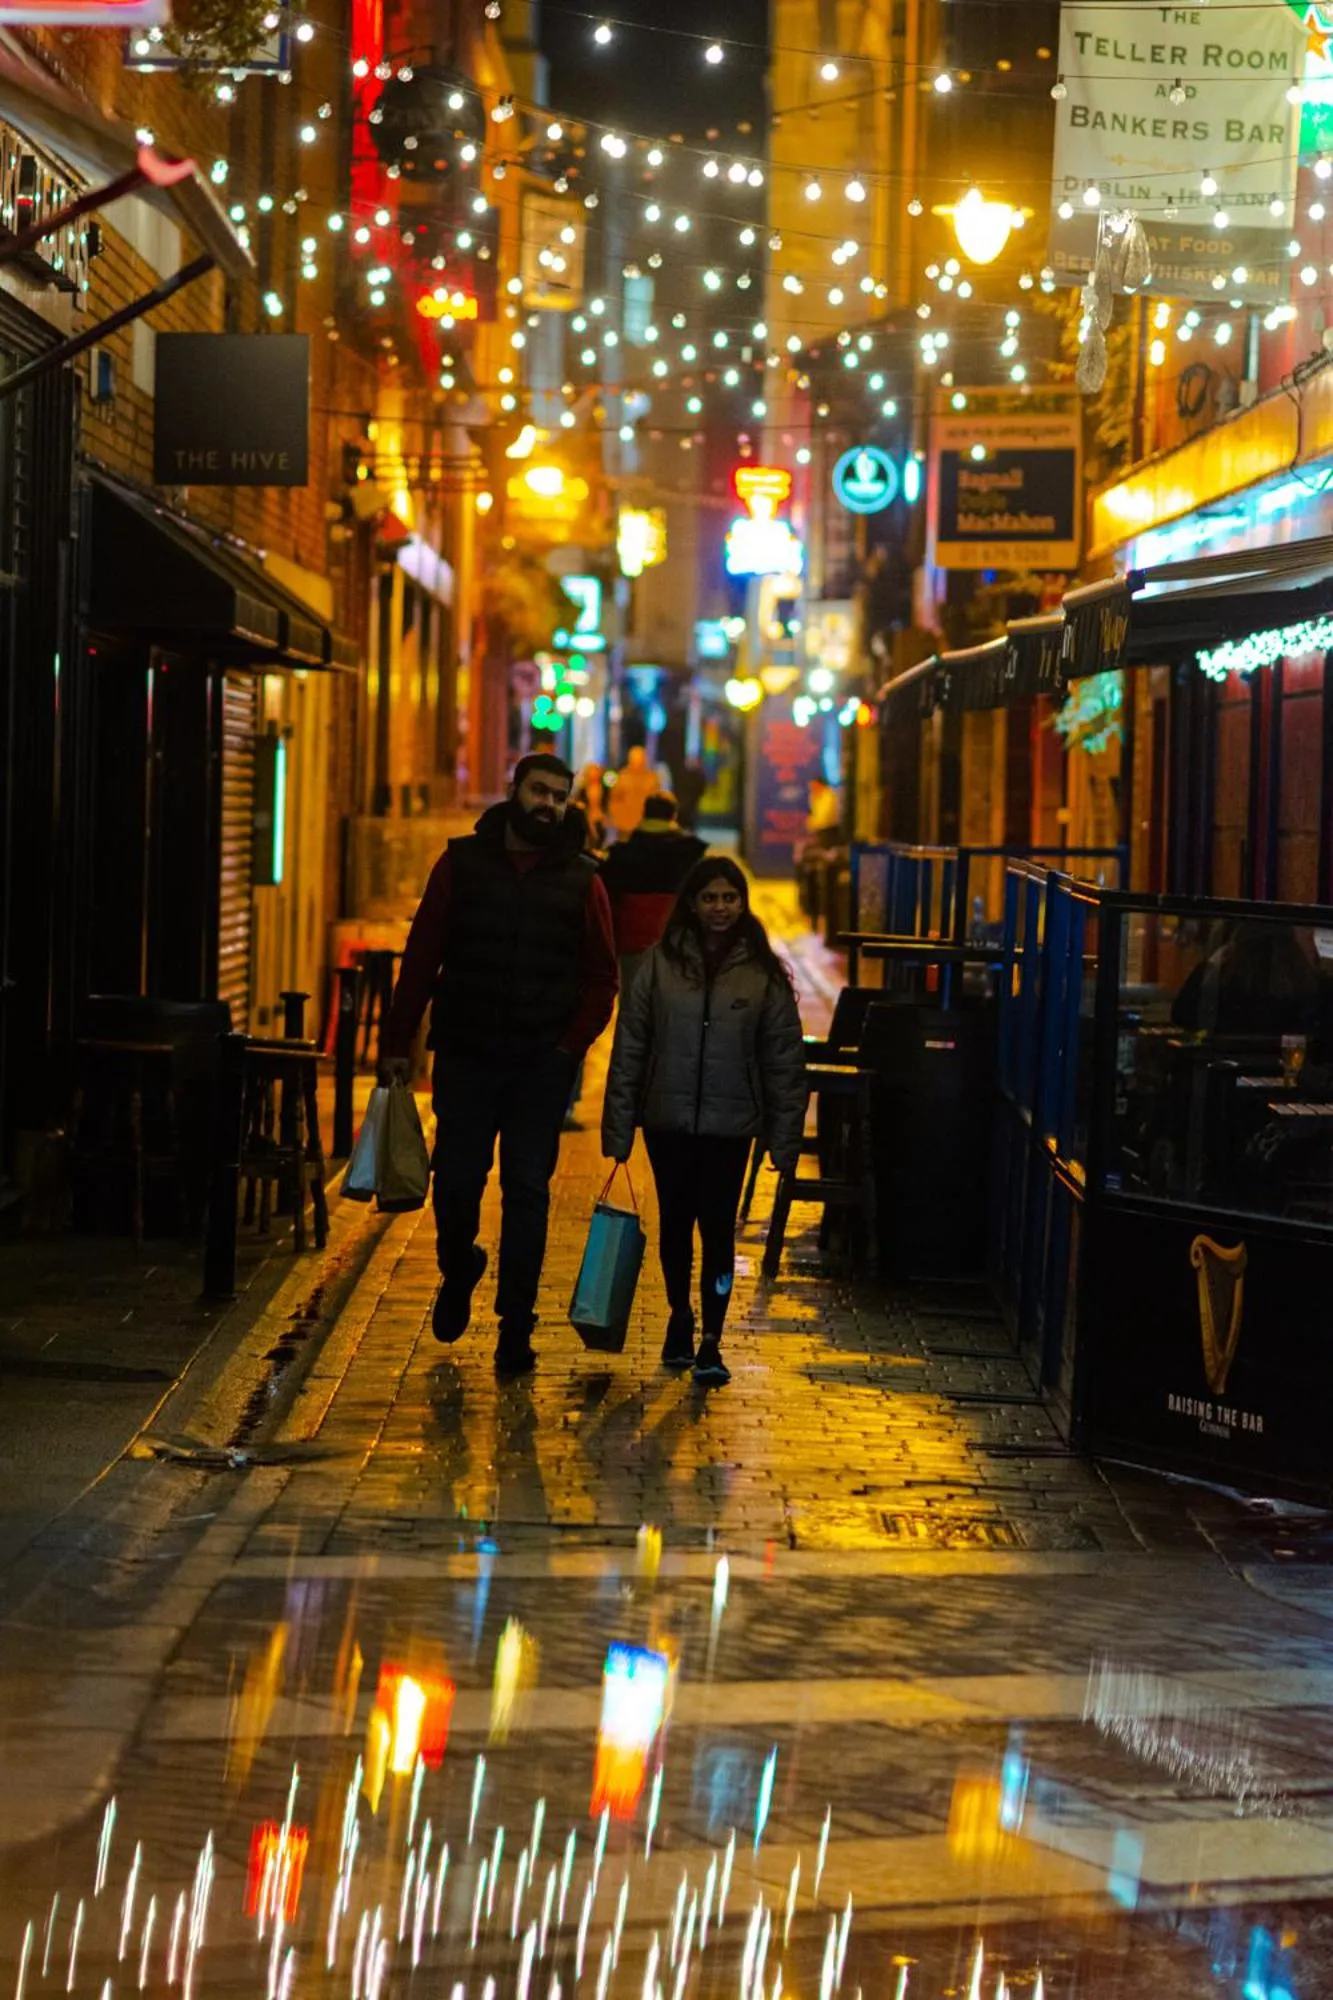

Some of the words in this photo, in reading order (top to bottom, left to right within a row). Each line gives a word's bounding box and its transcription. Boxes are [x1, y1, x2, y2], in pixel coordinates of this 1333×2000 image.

[1158, 7, 1201, 25] THE
[1074, 32, 1188, 65] TELLER
[1203, 44, 1288, 71] ROOM
[1155, 83, 1197, 99] AD
[1070, 105, 1210, 140] BANKERS
[1225, 119, 1285, 144] BAR
[1180, 235, 1234, 254] FOOD
[174, 450, 219, 470] THE
[231, 450, 290, 470] HIVE
[1168, 1393, 1213, 1420] RAISING
[1217, 1405, 1238, 1427] THE
[1241, 1411, 1264, 1433] BAR
